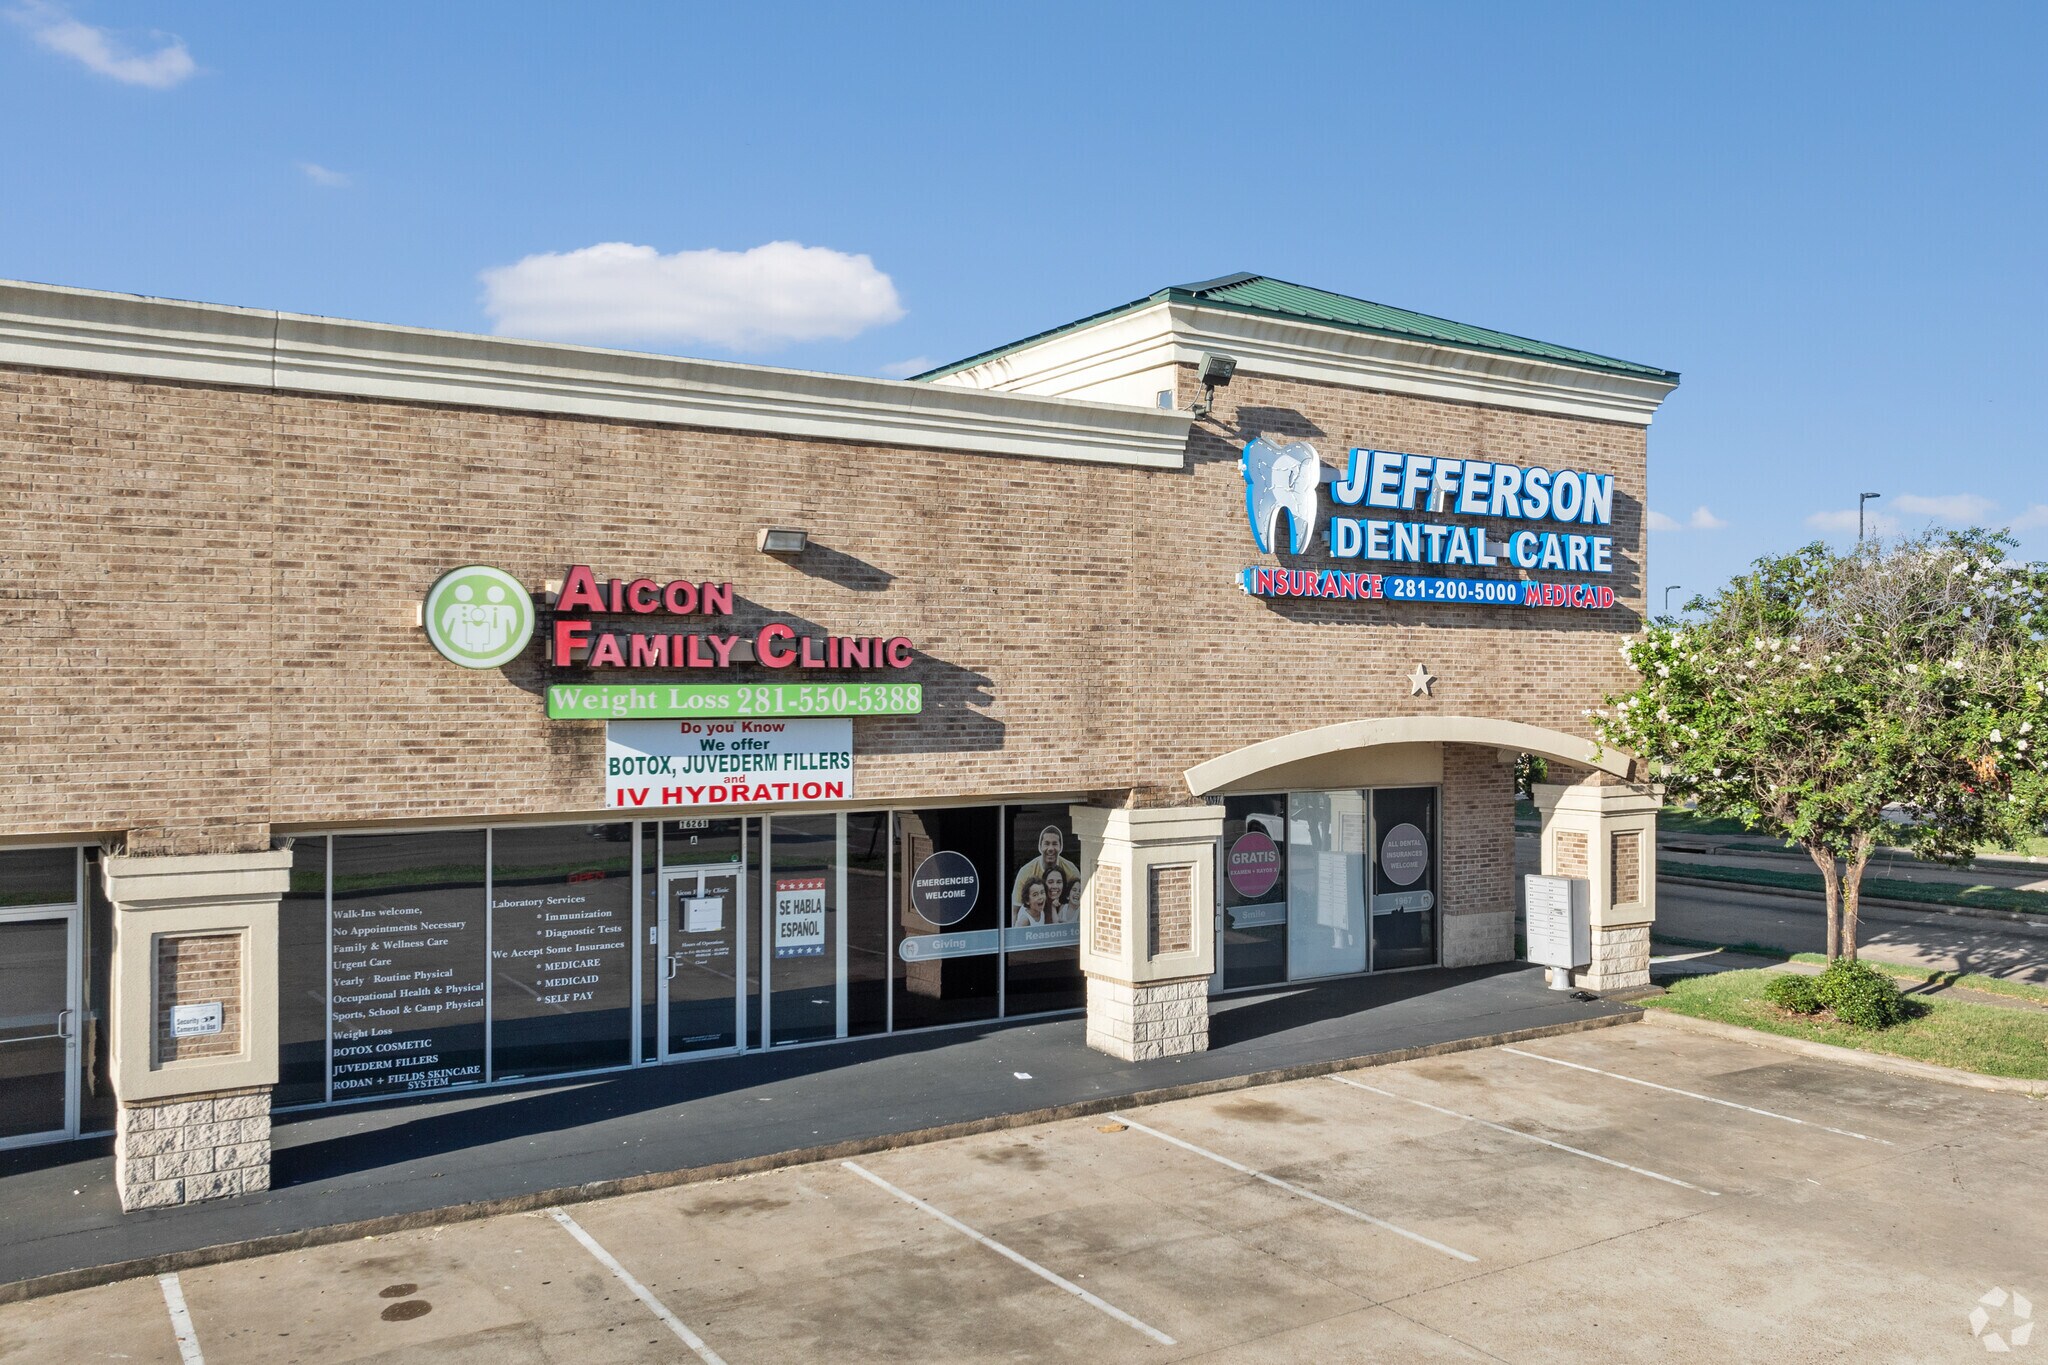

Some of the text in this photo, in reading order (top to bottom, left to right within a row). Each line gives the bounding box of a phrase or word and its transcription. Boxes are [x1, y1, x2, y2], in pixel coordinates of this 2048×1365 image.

[1330, 448, 1615, 526] JEFFERSON
[1330, 516, 1614, 573] DENTAL CARE
[554, 564, 734, 615] AICON
[1393, 578, 1517, 601] 281-200-5000
[1522, 580, 1615, 609] MEDICAID
[554, 619, 914, 669] FAMILY CLINIC
[551, 686, 921, 715] Weight Loss 281-550-5388
[681, 721, 785, 736] Do you Know
[700, 738, 770, 752] We offer
[609, 751, 850, 778] BOTOX, JUVEDERM FILLERS
[723, 774, 746, 784] and
[617, 781, 844, 806] IV HYDRATION
[1387, 839, 1421, 848] ALL DENTAL
[1231, 850, 1276, 864] GRATIS
[1386, 849, 1423, 858] INSURANCES
[1230, 868, 1252, 876] EXAMEN
[1390, 861, 1418, 869] WELCOME
[916, 875, 975, 888] EMERGENCIES
[492, 895, 586, 909] Laboratory Services
[925, 889, 966, 900] WELCOME
[333, 906, 423, 919] Walk-Ins welcome,
[779, 898, 822, 916] SE HABLA
[1242, 909, 1266, 920] Smile
[545, 909, 613, 921] Immunization
[333, 920, 467, 938] No Appointments Necessary
[545, 924, 623, 939] Diagnostic Tests
[781, 918, 820, 938] ESPAÑOL
[1025, 929, 1068, 941] Reasons
[333, 937, 449, 954] Family & Wellness Care
[492, 941, 625, 959] We Accept Some Insurances
[932, 938, 966, 950] Giving
[333, 957, 392, 972] Urgent Care
[544, 958, 601, 972] MEDICARE
[333, 968, 454, 988] Yearly Routine Physical
[544, 974, 600, 988] MEDICAID
[333, 982, 485, 1004] Occupational Health & Physical
[544, 991, 595, 1004] SELF PAY
[332, 998, 485, 1023] Sports, School & Camp Physical
[333, 1026, 394, 1041] Weight Loss
[333, 1038, 433, 1057] BOTOX COSMETIC
[333, 1054, 439, 1077] JUVEDERM FILLERS
[333, 1064, 481, 1091] RODAN + FIELDS SKINCARE
[407, 1076, 450, 1091] SYSTEM
